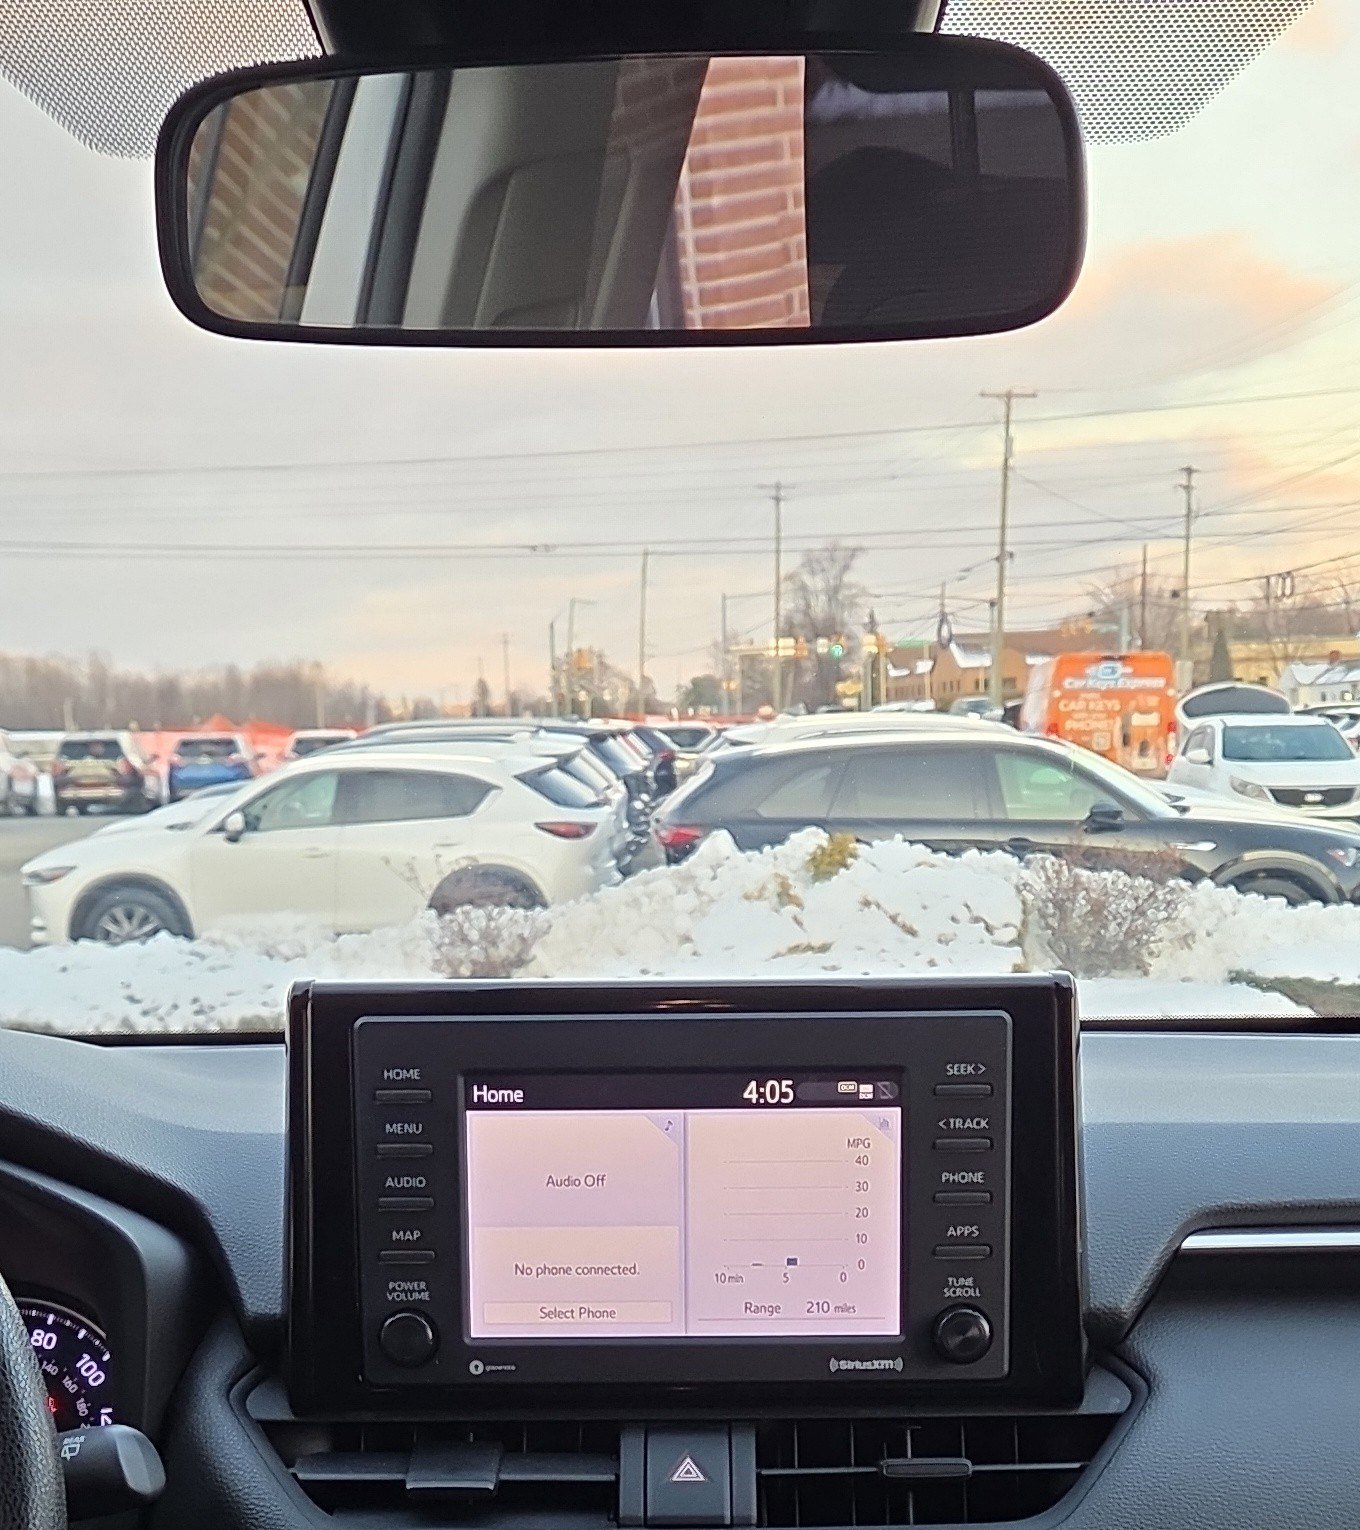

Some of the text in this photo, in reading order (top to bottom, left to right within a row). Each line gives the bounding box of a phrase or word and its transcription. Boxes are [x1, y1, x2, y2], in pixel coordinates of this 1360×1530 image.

[384, 1069, 421, 1080] HOME
[946, 1064, 975, 1075] SEEK
[473, 1085, 524, 1103] Home
[742, 1080, 794, 1104] 4:05
[385, 1123, 422, 1134] MENU
[949, 1118, 989, 1129] TRACK
[847, 1138, 870, 1149] MPG
[855, 1155, 869, 1166] 40
[385, 1177, 426, 1188] AUDIO
[546, 1174, 606, 1187] Audio Off
[942, 1172, 985, 1183] PHONE
[855, 1181, 869, 1192] 30
[855, 1207, 869, 1218] 20
[392, 1230, 421, 1241] MAP
[947, 1226, 980, 1237] APPS
[856, 1233, 868, 1244] 10
[858, 1259, 865, 1270] 0
[514, 1263, 640, 1278] No phone connected.
[715, 1273, 744, 1283] 10 min
[783, 1272, 789, 1283] 5
[840, 1272, 847, 1282] 0
[947, 1277, 974, 1287] TUNE
[389, 1281, 426, 1291] POWER
[387, 1291, 430, 1301] VOLUME
[943, 1287, 981, 1297] SCROLL
[540, 1306, 616, 1319] Select Phone
[744, 1301, 856, 1316] Range 210 miles
[30, 1329, 57, 1350] 80
[75, 1353, 105, 1386] 100
[62, 1376, 79, 1393] 160
